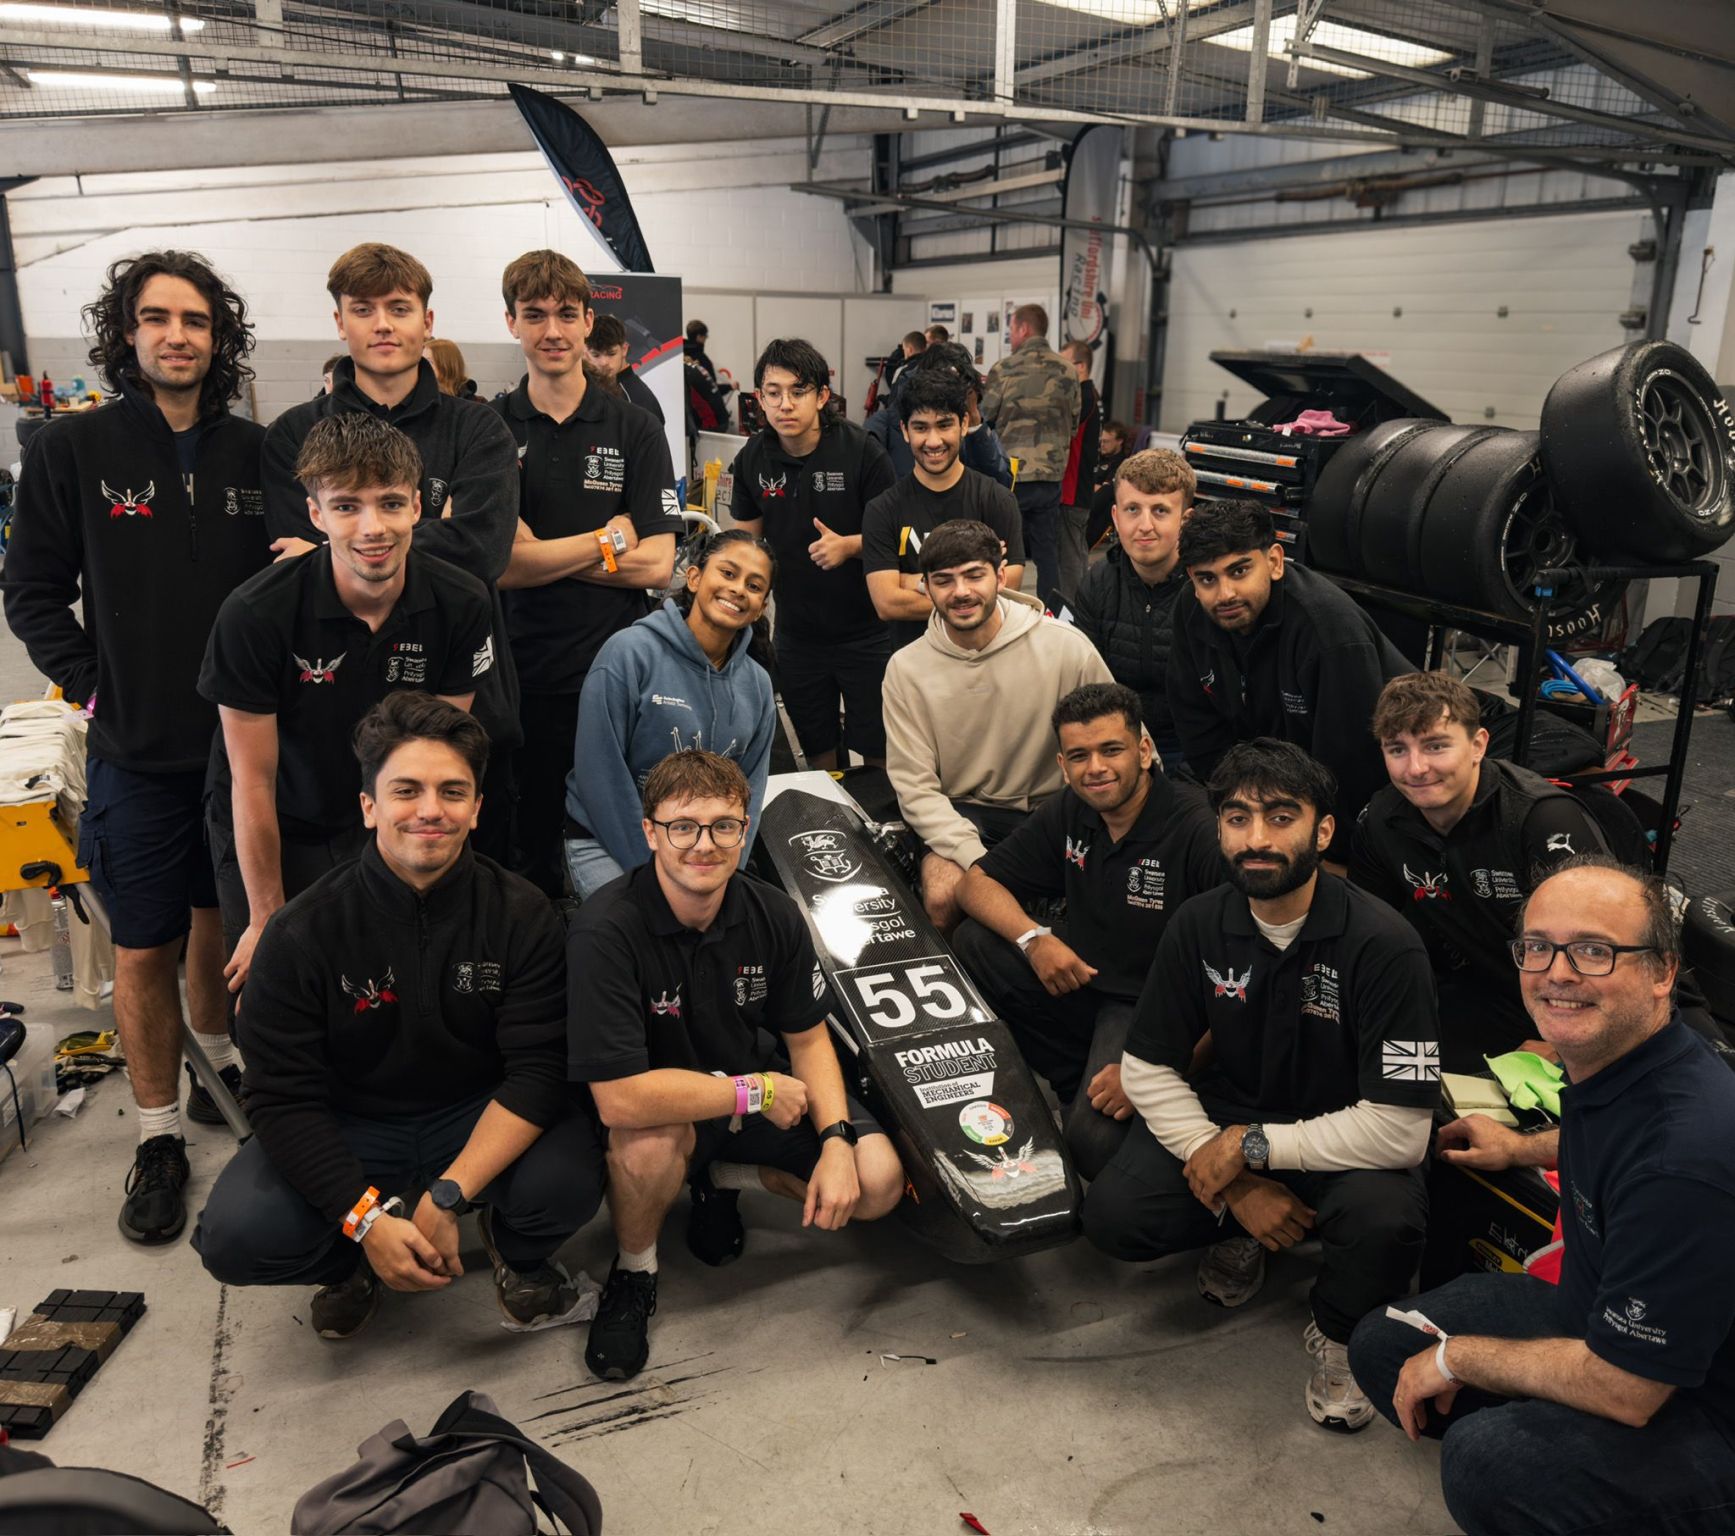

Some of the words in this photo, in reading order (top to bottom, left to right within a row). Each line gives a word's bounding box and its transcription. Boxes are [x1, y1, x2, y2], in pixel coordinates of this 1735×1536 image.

[854, 965, 967, 1028] 55
[894, 1037, 996, 1067] FORMULA
[903, 1053, 998, 1084] STUDENT
[922, 1081, 981, 1098] MECHANICAL
[925, 1089, 975, 1104] ENGINEERS
[1628, 1320, 1667, 1336] University
[1629, 1329, 1667, 1345] Abertawe
